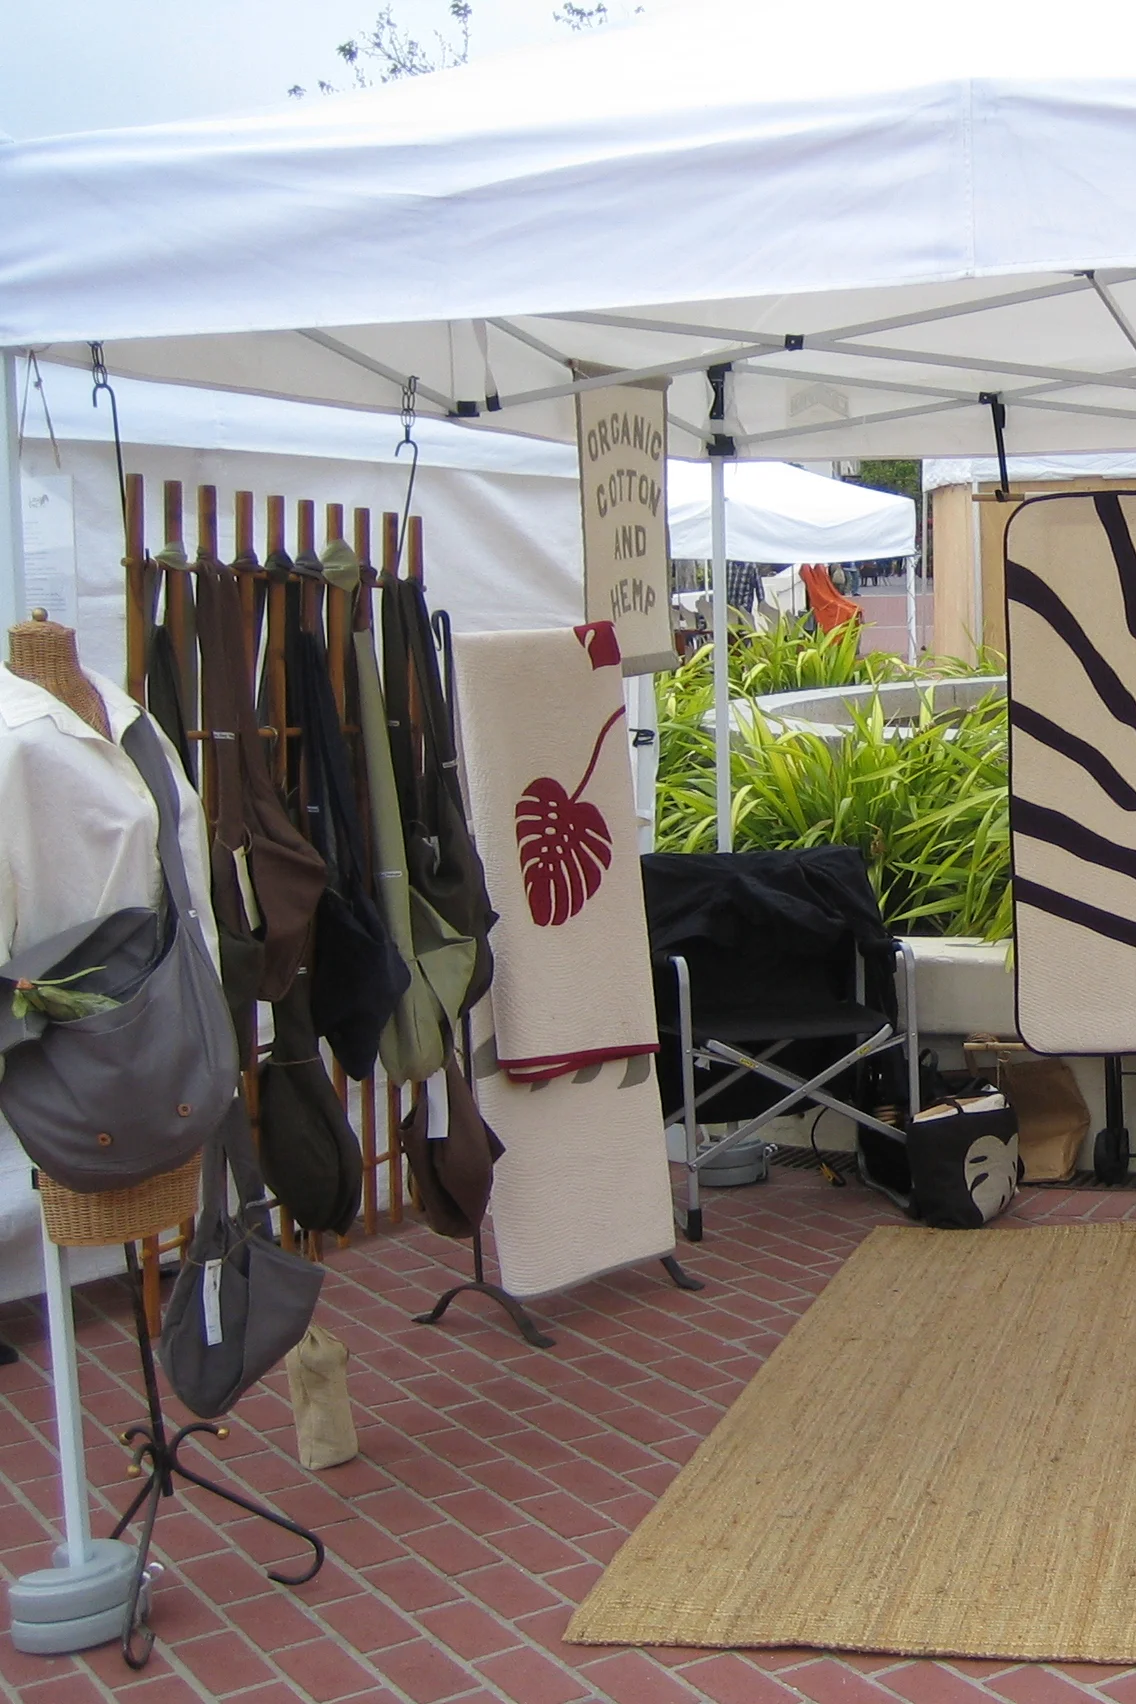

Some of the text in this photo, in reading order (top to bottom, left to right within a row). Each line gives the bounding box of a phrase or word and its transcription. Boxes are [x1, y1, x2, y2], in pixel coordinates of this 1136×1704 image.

[587, 411, 662, 462] ORGANIC
[596, 468, 662, 518] COTTON
[614, 525, 647, 560] AND
[611, 577, 656, 622] HEMP
